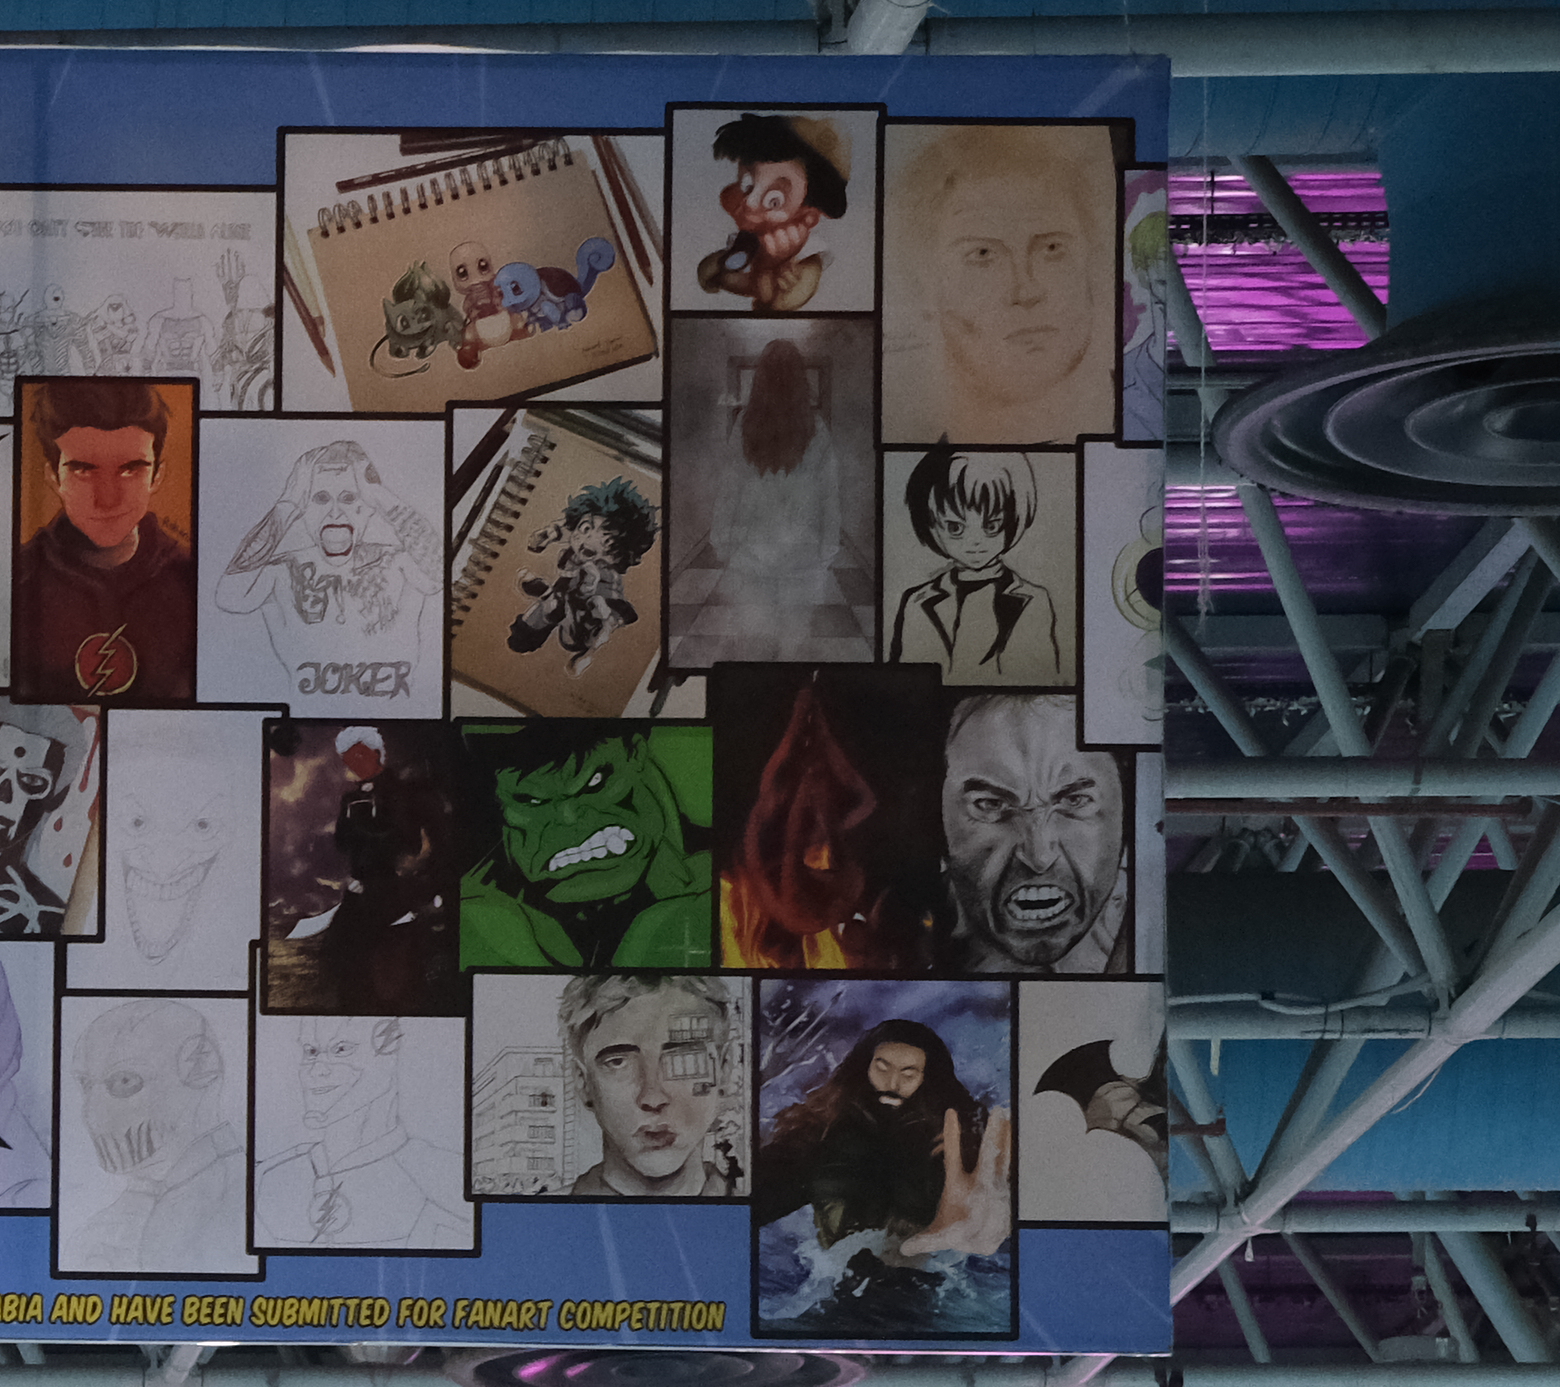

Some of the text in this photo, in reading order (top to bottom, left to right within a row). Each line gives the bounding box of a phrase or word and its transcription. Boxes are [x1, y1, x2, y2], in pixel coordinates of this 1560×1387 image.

[297, 661, 412, 699] JOKER
[50, 1293, 101, 1325] AND
[109, 1294, 176, 1326] HAVE
[181, 1295, 245, 1327] BEEN
[249, 1294, 390, 1328] SUBMITTED
[396, 1297, 447, 1328] FOR
[452, 1298, 554, 1331] FANART
[558, 1299, 726, 1332] COMPETITION
